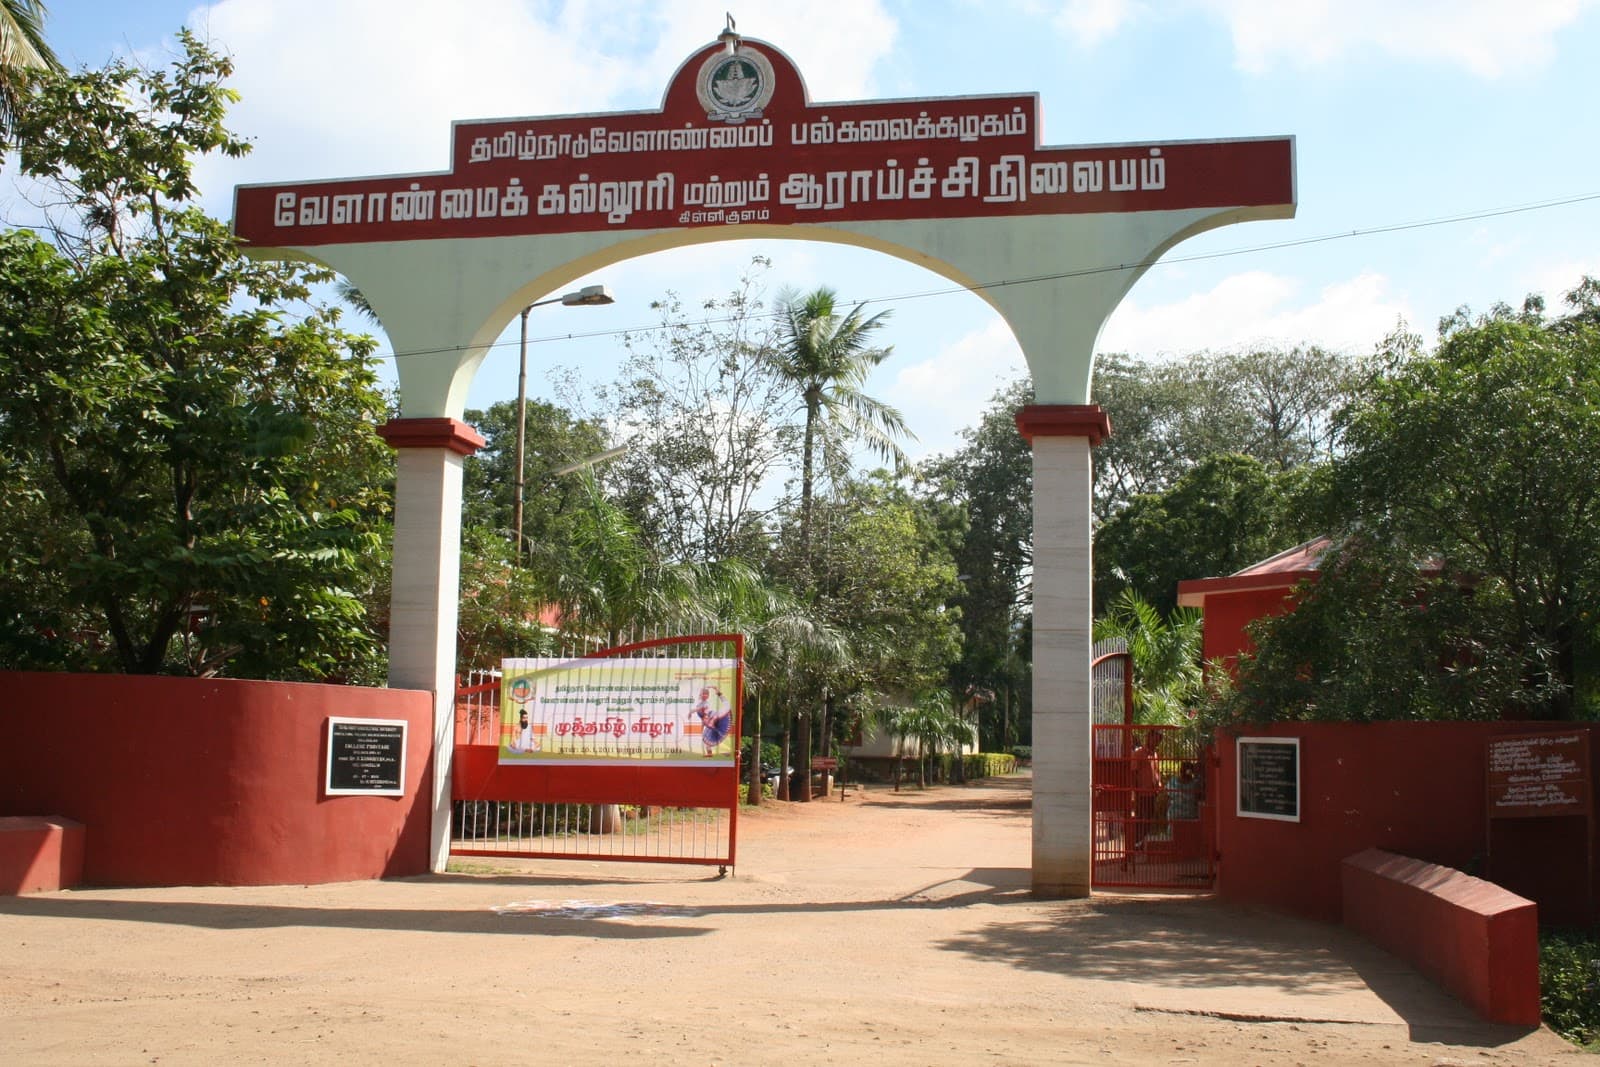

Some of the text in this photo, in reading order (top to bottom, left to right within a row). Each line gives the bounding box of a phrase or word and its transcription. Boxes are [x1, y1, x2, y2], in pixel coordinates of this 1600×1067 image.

[791, 107, 1027, 145] பல்கலைக்கழகம்
[273, 148, 1166, 227] வேளாண்மைக் கல்லூரி மற்றும் ஆராய்ச்சி நிலையம்
[555, 716, 674, 738] முத்தமிழ் விழா
